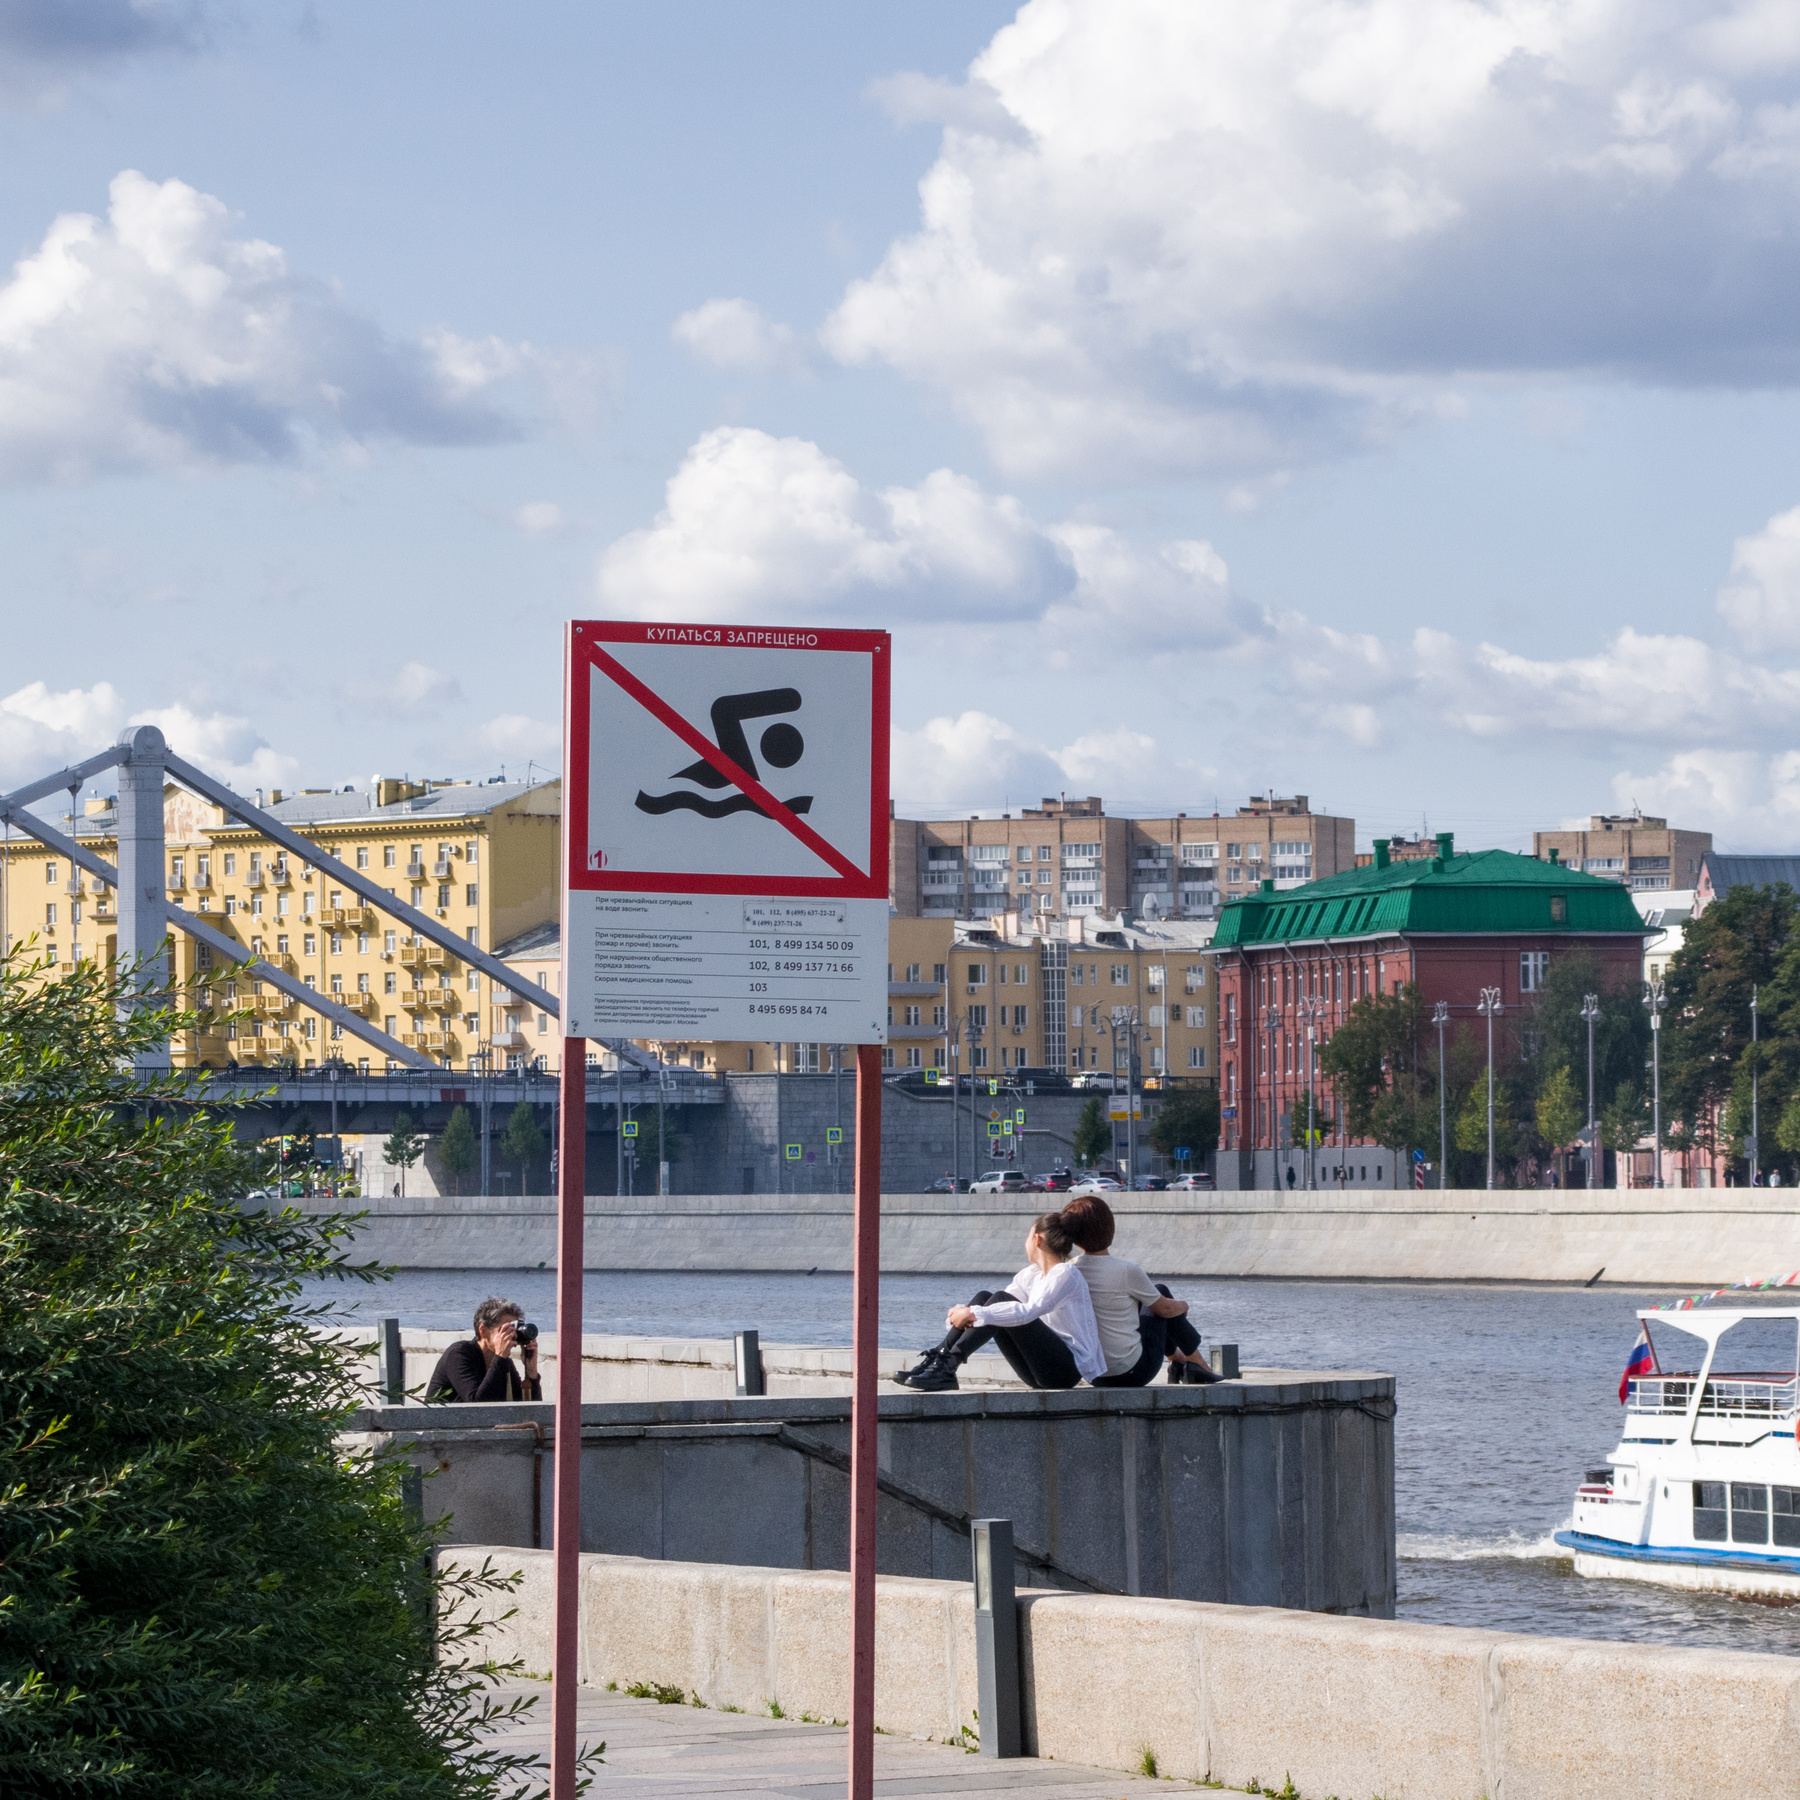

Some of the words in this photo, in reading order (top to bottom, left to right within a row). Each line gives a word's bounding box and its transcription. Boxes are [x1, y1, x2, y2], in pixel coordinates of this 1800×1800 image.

[647, 628, 721, 642] КУПАТЬСЯ
[727, 630, 818, 646] ЗАПРЕЩЕНО
[590, 850, 608, 868] (1)
[749, 939, 770, 949] 101,
[775, 940, 781, 948] 8
[784, 940, 802, 949] 499
[805, 941, 823, 949] 134
[827, 941, 838, 950] 50
[841, 942, 854, 950] 09
[749, 961, 770, 971] 102,
[775, 962, 781, 970] 8
[784, 962, 802, 971] 499
[805, 963, 823, 971] 137
[826, 963, 838, 972] 71
[841, 964, 854, 972] 66
[749, 983, 768, 991] 103
[749, 1005, 755, 1013] 8
[758, 1005, 776, 1014] 495
[779, 1005, 798, 1014] 695
[800, 1006, 812, 1014] 84
[815, 1006, 827, 1015] 74
